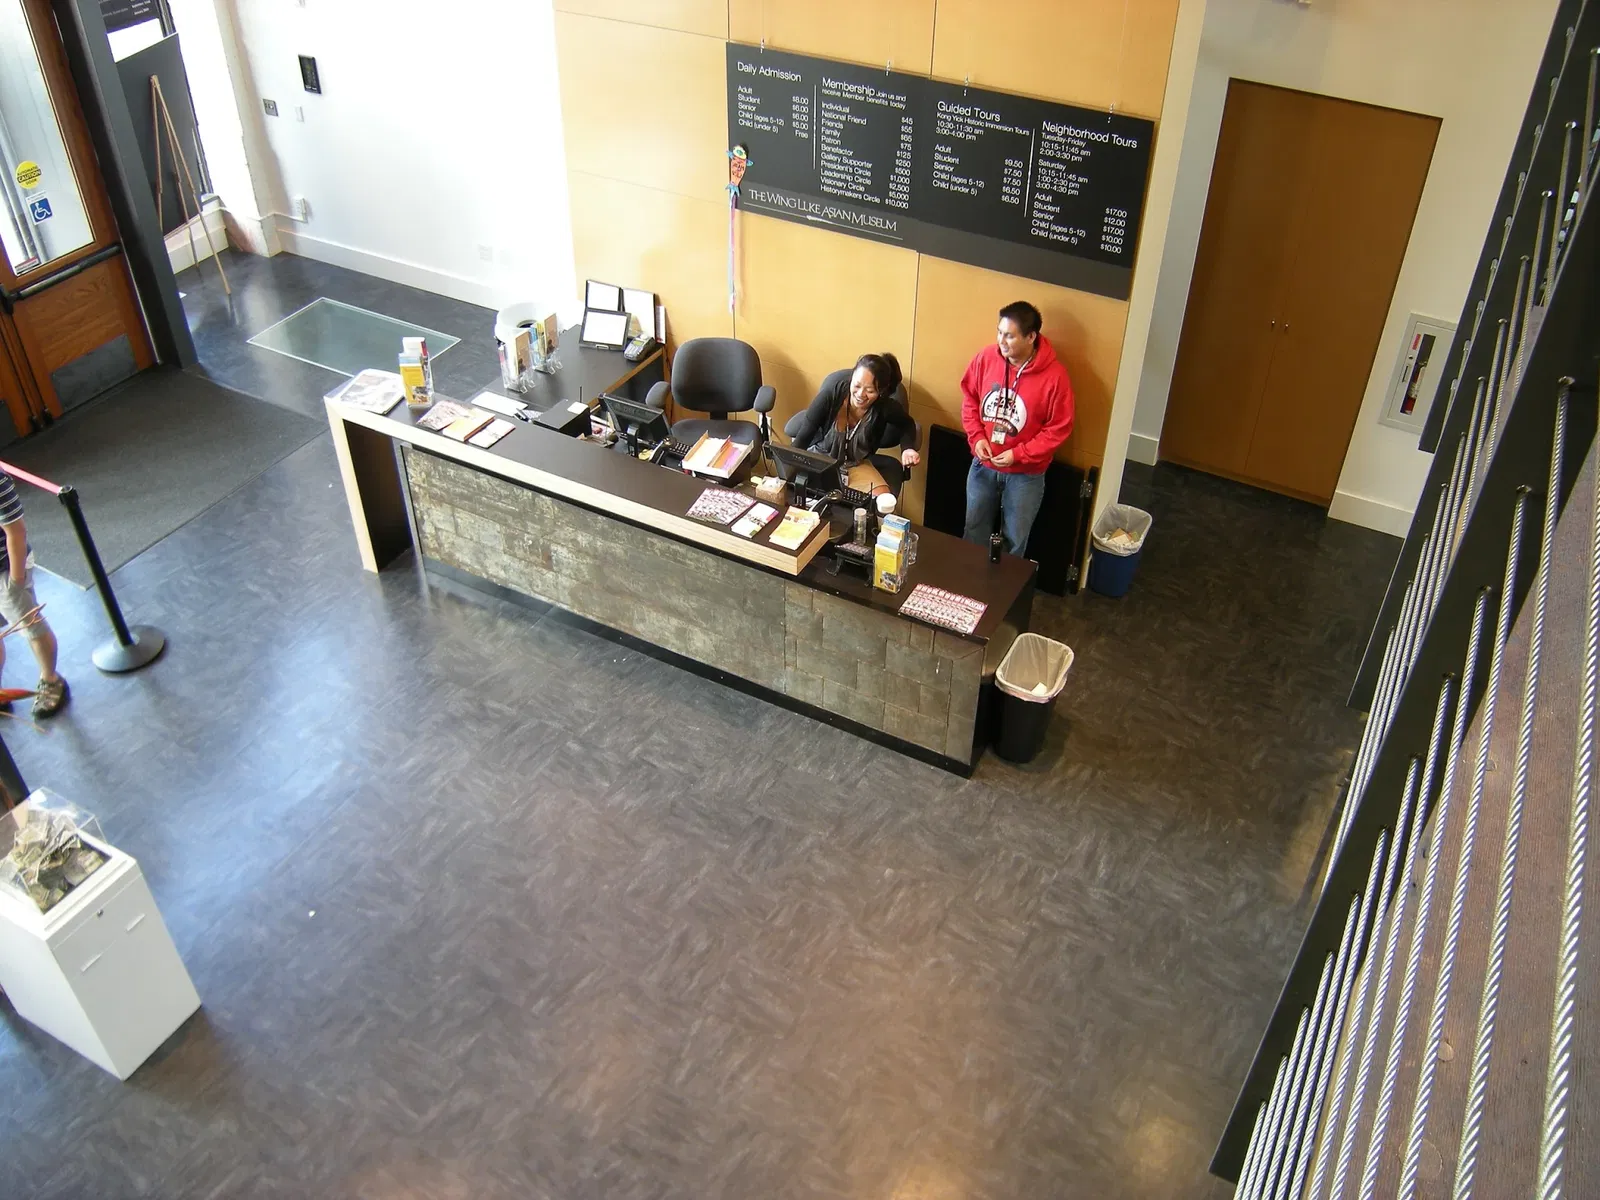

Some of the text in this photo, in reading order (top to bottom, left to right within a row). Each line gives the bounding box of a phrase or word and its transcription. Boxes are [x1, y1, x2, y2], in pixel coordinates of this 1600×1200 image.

[738, 62, 801, 82] Daily Admission
[738, 86, 808, 104] Adult $8.00
[822, 77, 875, 96] Membership
[738, 94, 808, 113] Student $6.00
[822, 101, 849, 113] Individual
[842, 92, 865, 101] Member
[866, 97, 888, 106] benefits
[890, 101, 906, 110] today
[738, 102, 808, 121] Senior $6.00
[738, 110, 808, 130] Child (ages 5-12) $5.00
[822, 110, 846, 121] National
[847, 115, 867, 125] Friend
[938, 101, 1000, 122] Guided Tours
[739, 119, 753, 127] Child
[754, 122, 771, 131] (under
[795, 130, 808, 138] Free
[822, 119, 843, 129] Friends
[822, 127, 840, 138] Family
[936, 127, 965, 138] 3:00-4:00
[937, 112, 952, 122] Kong
[965, 118, 984, 127] Historic
[986, 122, 1014, 132] Immersion
[1015, 127, 1029, 136] Tours
[937, 121, 973, 133] 10:30-11:30
[1042, 132, 1086, 148] Tuesday-Friday
[1043, 121, 1137, 148] Neighborhood Tours
[821, 136, 911, 159] Patron $125
[821, 144, 911, 167] Benefactor $250
[935, 144, 1023, 168] Adult $9.50
[1040, 148, 1070, 160] 2:00-3:30
[1042, 141, 1079, 154] 10:15-11:45
[821, 152, 910, 176] Gallery Supporter $500
[821, 160, 910, 184] President's Circle $1,000
[934, 153, 1022, 177] Student $7.50
[934, 162, 1021, 186] Senior $7.50
[1038, 159, 1066, 171] Saturday
[18, 169, 41, 182] CAUTION
[821, 168, 909, 192] Leadership Circle $2,500
[933, 171, 1020, 195] Child (ages 5-12) $6.50
[1038, 175, 1068, 186] 1:00-2:30
[1039, 168, 1076, 181] 10:15-11:45
[821, 177, 909, 201] Visionary Circle $5,000
[821, 184, 908, 209] Historymakers Circle $10,000
[933, 180, 948, 189] Child
[950, 184, 969, 193] (under
[1002, 195, 1019, 204] $6.50
[1036, 182, 1067, 193] 3:00-4:30
[749, 189, 896, 231] THE WING LUKE ASIAN MUSEUM
[1034, 202, 1125, 227] Student $12.00
[1035, 193, 1127, 218] Adult $17.00
[1032, 219, 1123, 245] Child (ages 5-12) $10.00
[1033, 211, 1124, 236] Senior $17.00
[1031, 228, 1048, 237] Child
[1049, 232, 1069, 242] (under
[1100, 244, 1121, 254] $10.00
